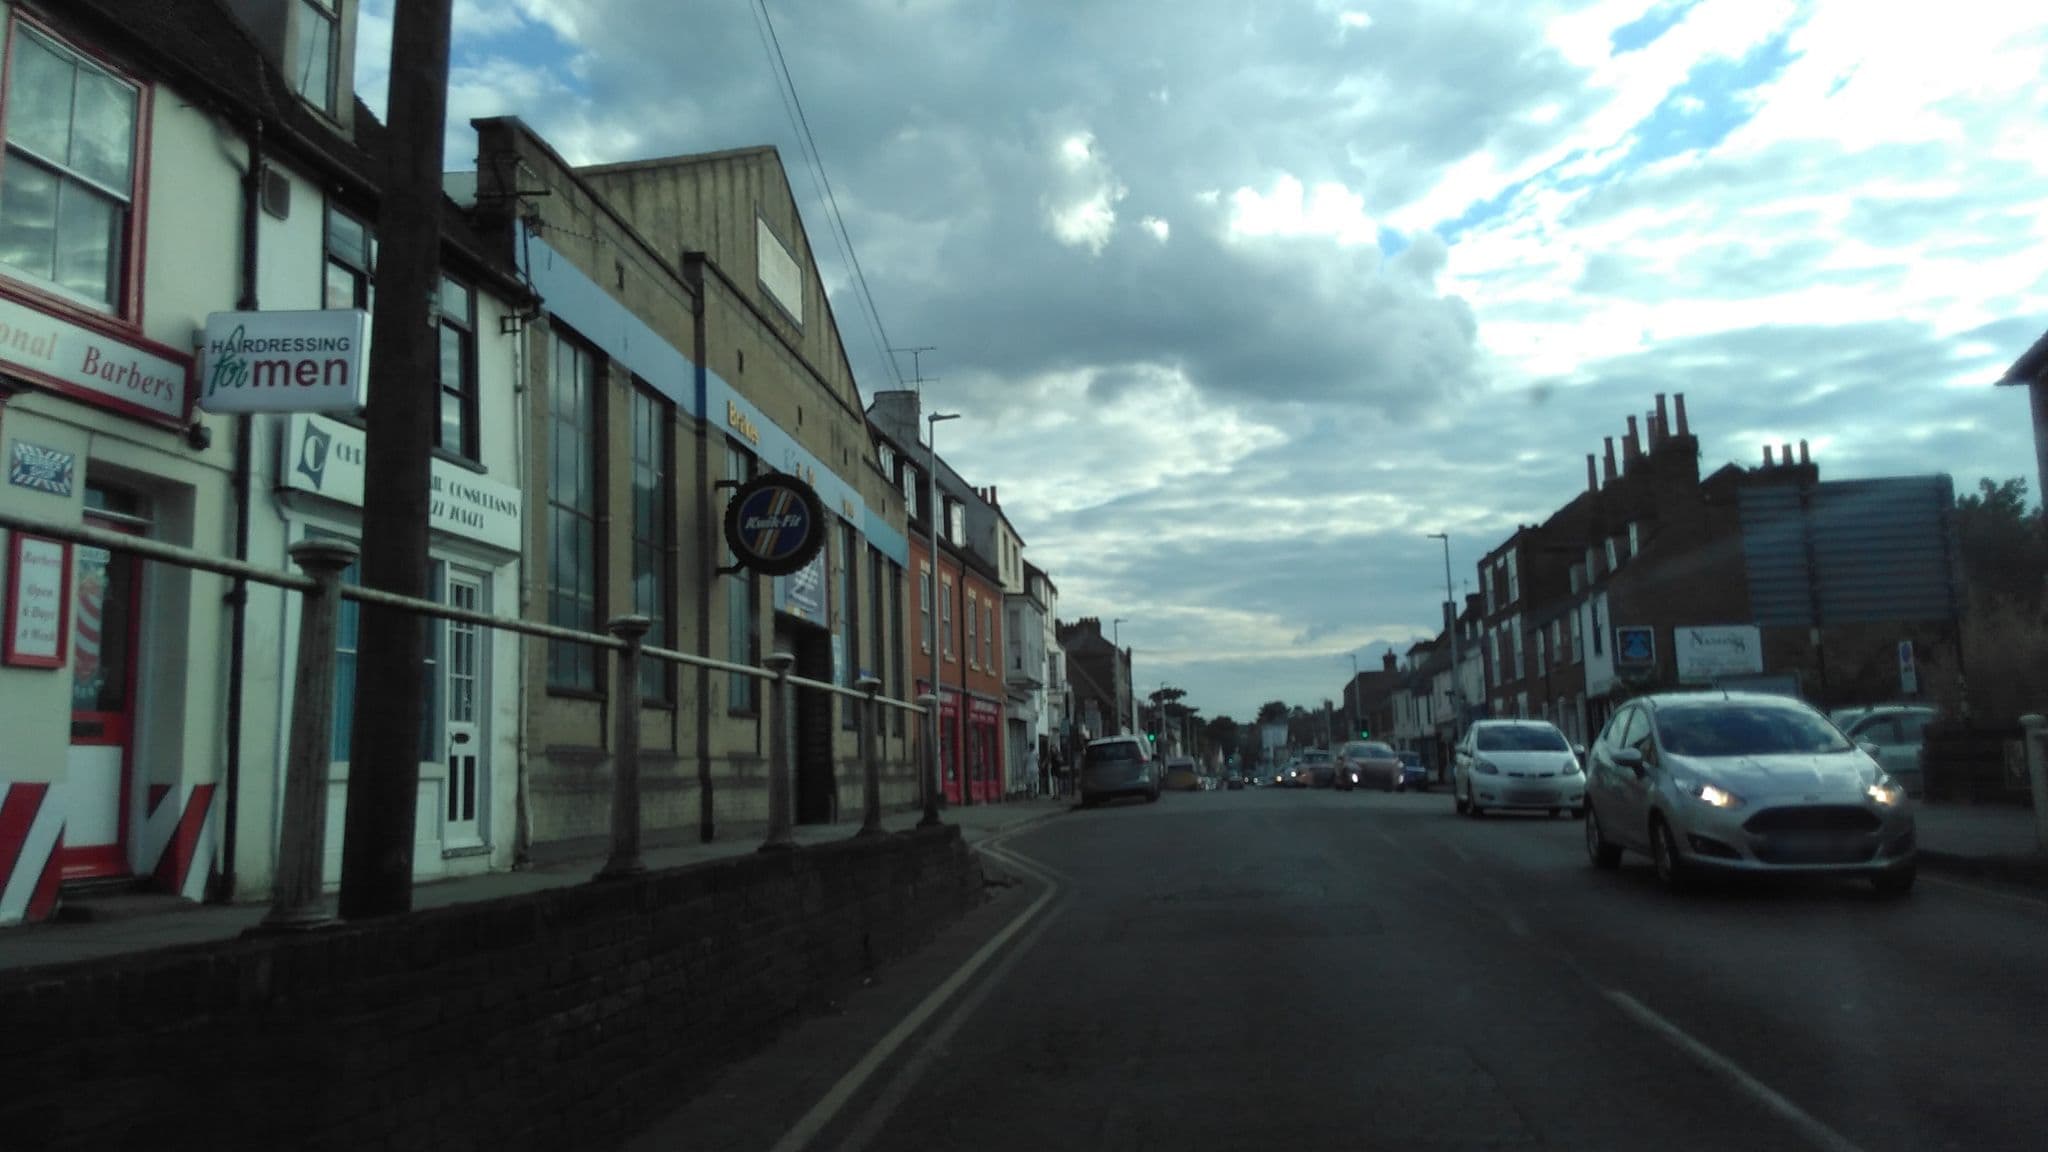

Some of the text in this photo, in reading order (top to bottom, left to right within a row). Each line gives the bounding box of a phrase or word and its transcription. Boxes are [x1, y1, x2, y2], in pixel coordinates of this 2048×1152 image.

[210, 329, 350, 354] HAIRDRESSING
[208, 353, 349, 397] for men
